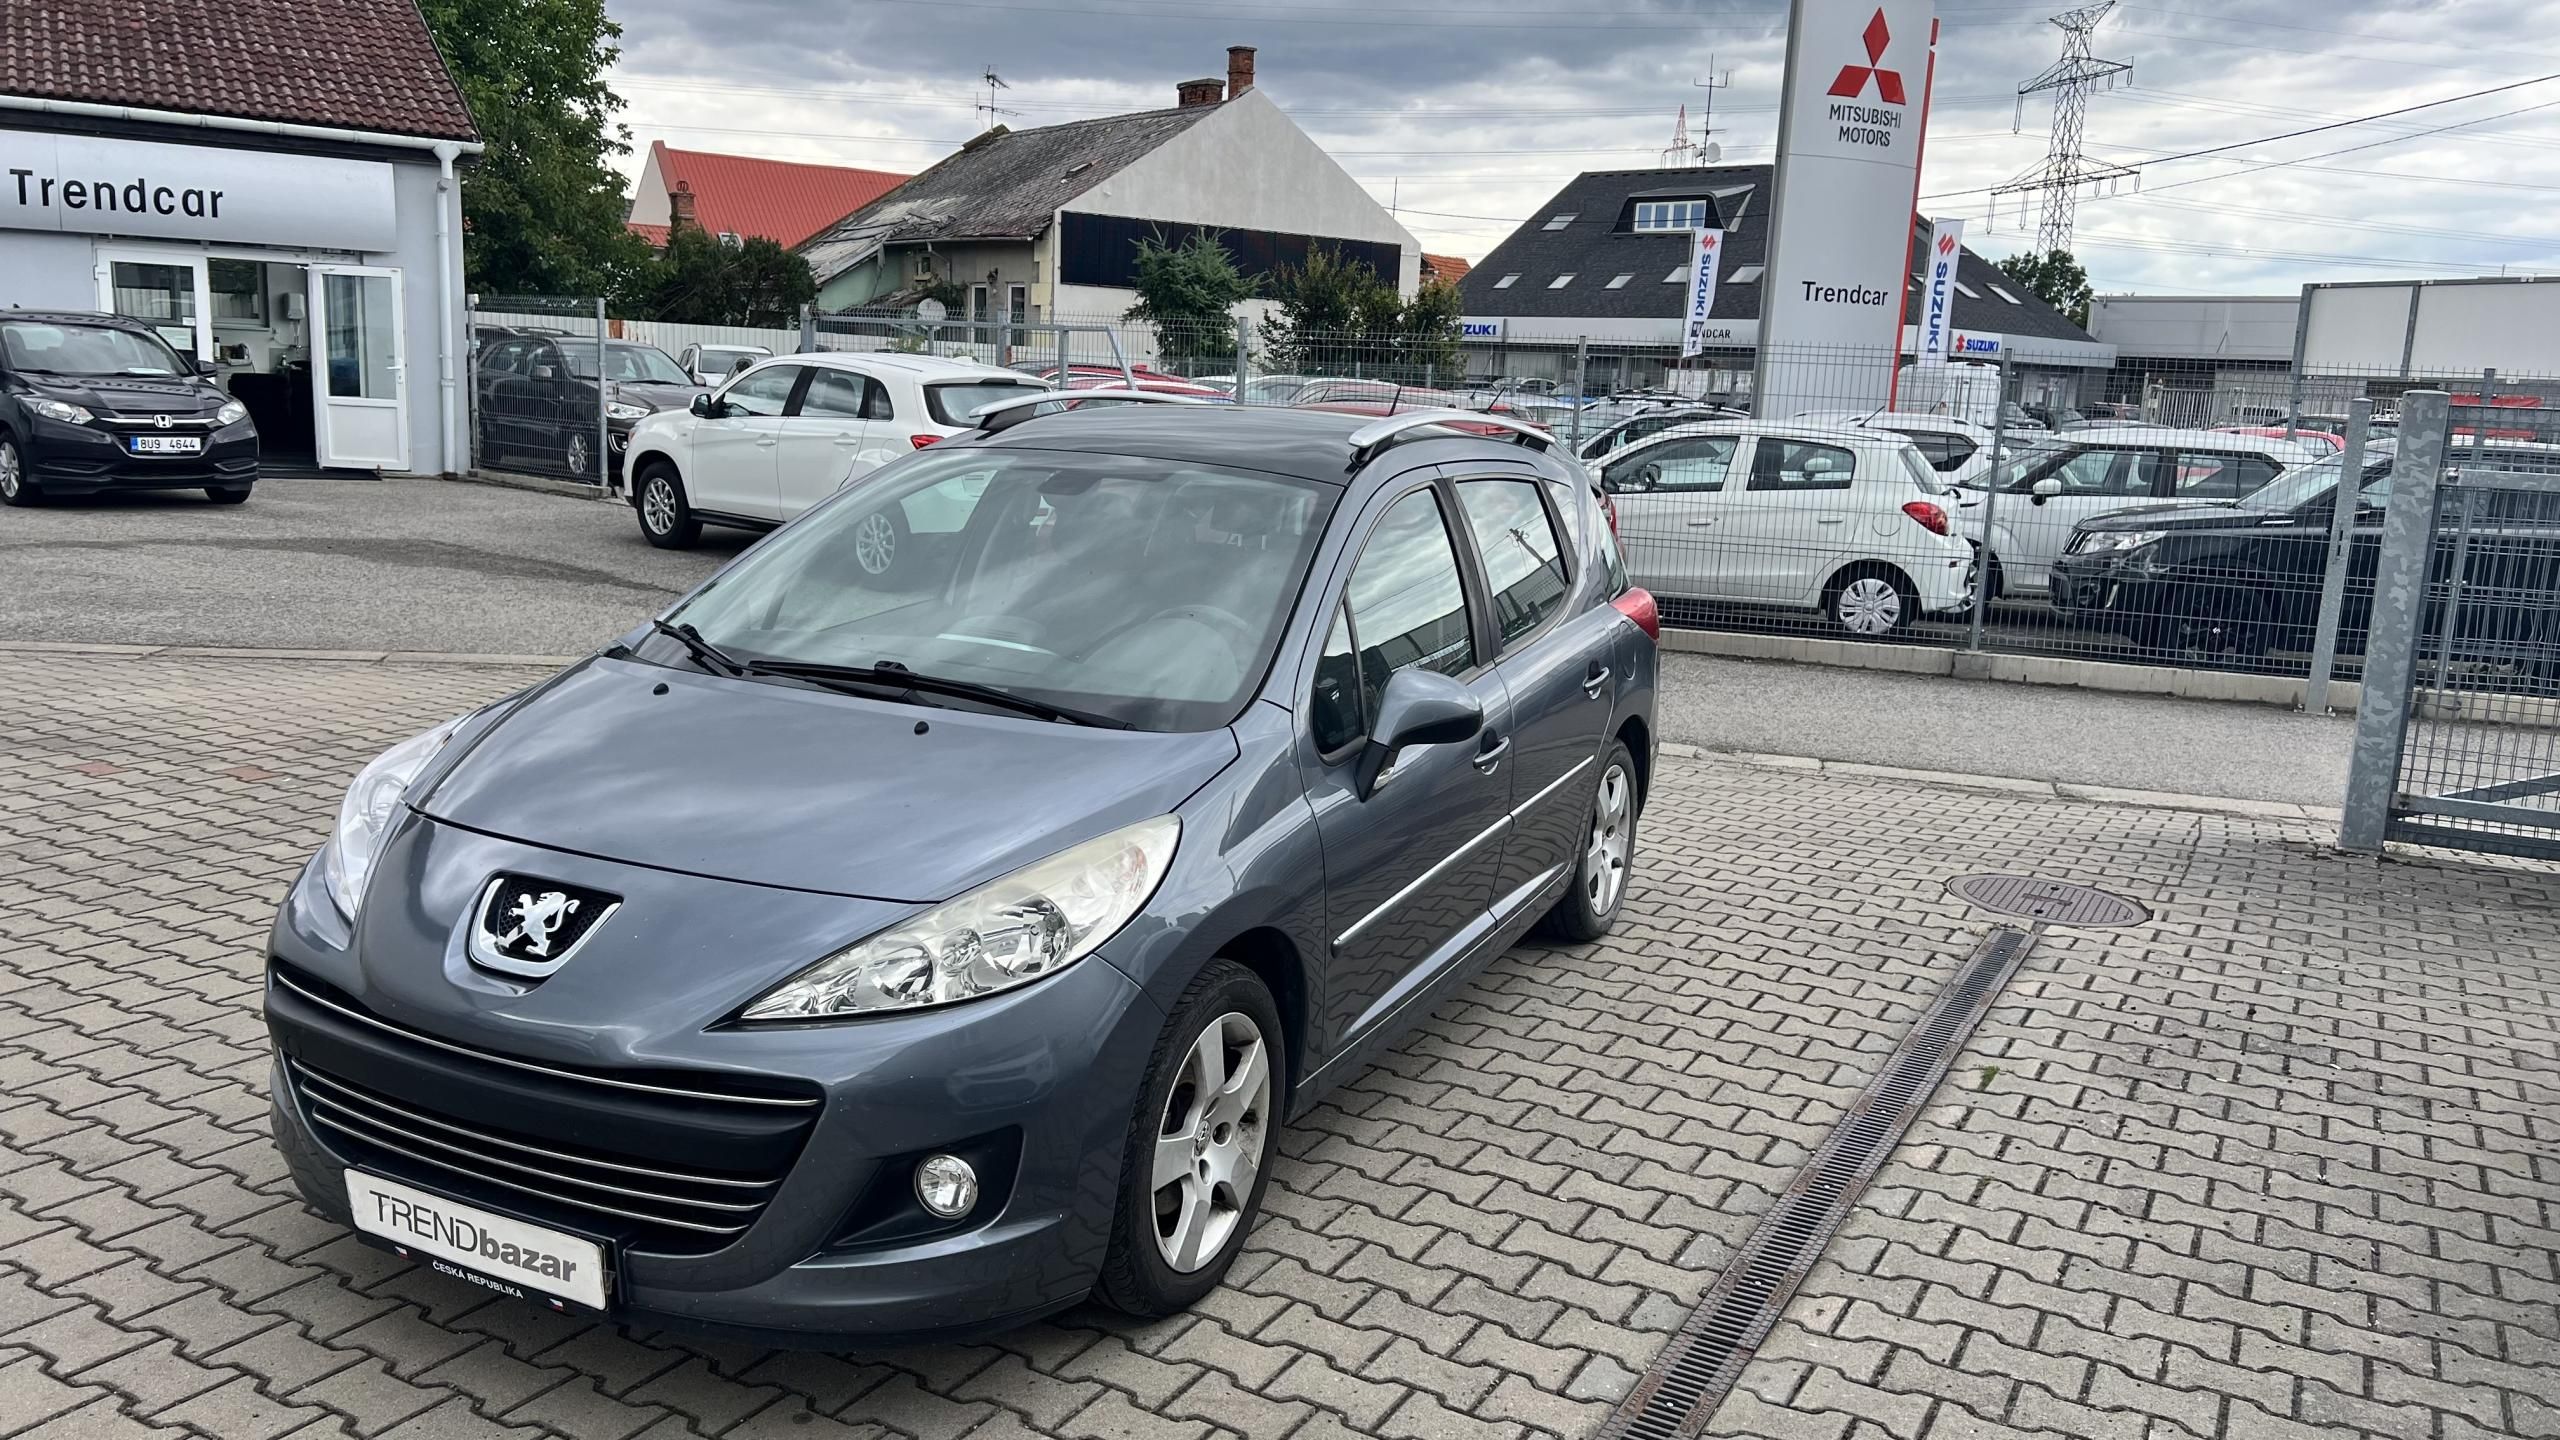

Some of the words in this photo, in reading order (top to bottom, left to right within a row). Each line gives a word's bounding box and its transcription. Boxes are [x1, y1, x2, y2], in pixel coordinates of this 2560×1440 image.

[1829, 103, 1902, 129] MITSUBISHI
[1838, 125, 1891, 148] MOTORS
[9, 168, 224, 219] Trendcar
[1694, 253, 1712, 317] SUZUKI
[1801, 280, 1889, 307] Trendcar
[1927, 261, 1949, 354] SUZUKI
[1462, 324, 1497, 336] ZUKI
[1701, 328, 1731, 339] NDCAR
[1965, 338, 2000, 353] SUZUKI
[140, 438, 161, 449] 8U9
[169, 438, 196, 449] 4644
[368, 1189, 578, 1283] TRENDbazar
[432, 1258, 465, 1281] ČESKÁ
[466, 1271, 524, 1300] REPUBLIKA
